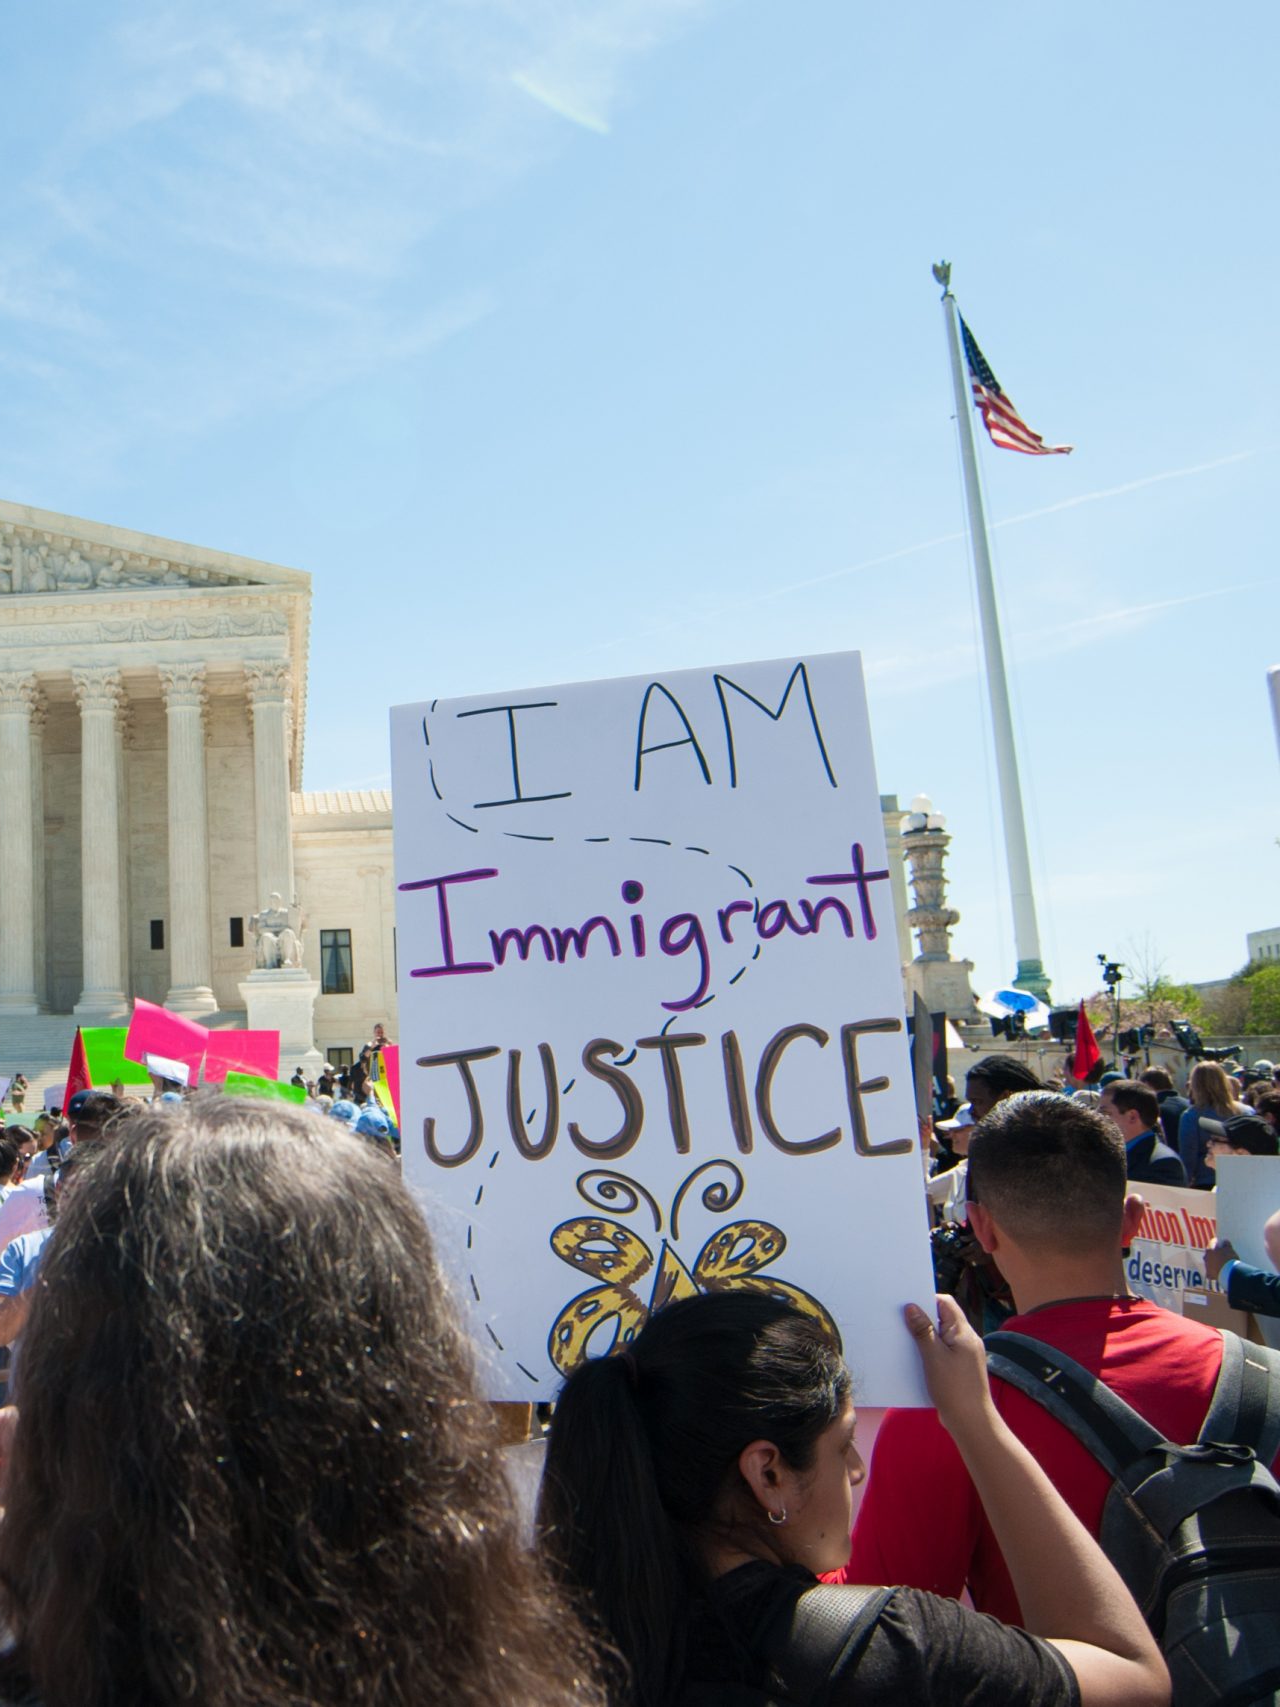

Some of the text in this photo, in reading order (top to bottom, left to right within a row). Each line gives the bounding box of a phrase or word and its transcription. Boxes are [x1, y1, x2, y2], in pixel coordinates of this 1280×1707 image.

[457, 661, 839, 809] I AM
[397, 842, 891, 1012] Immigrant
[415, 1017, 914, 1170] JUSTICE
[1180, 1207, 1217, 1249] Im
